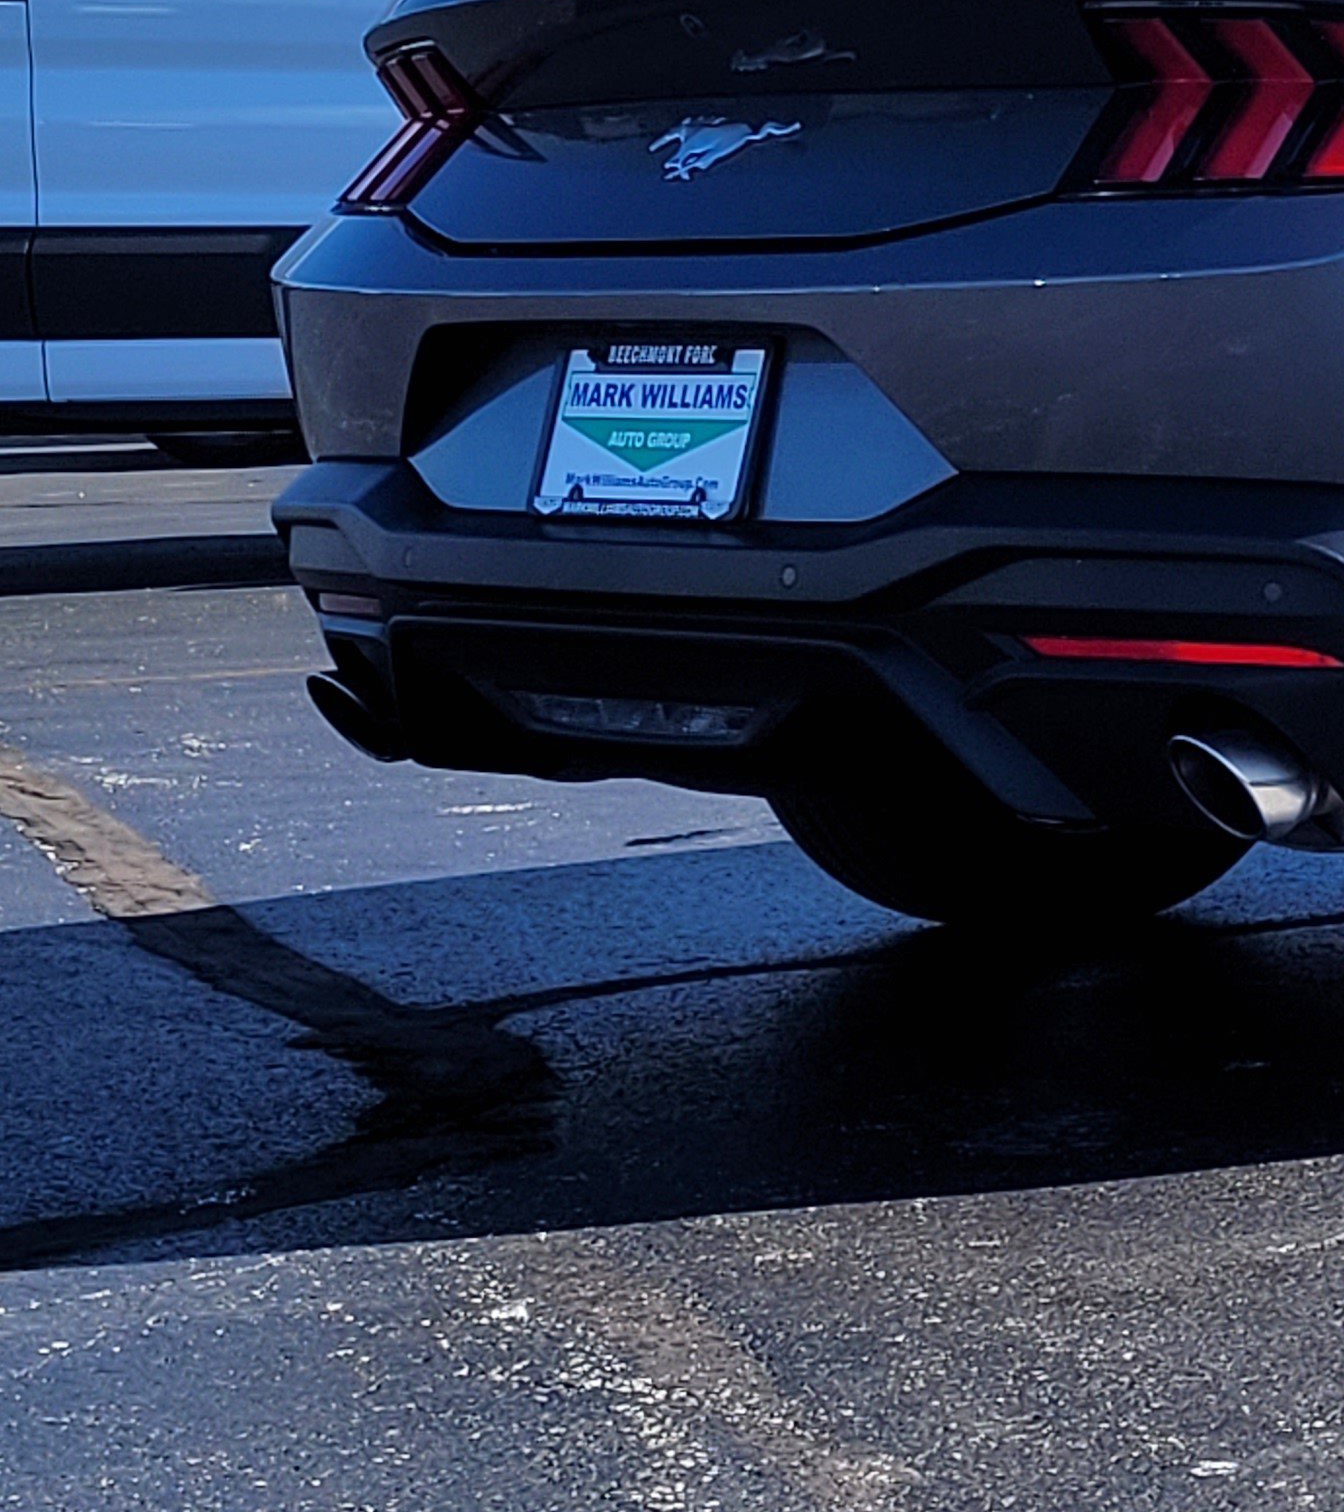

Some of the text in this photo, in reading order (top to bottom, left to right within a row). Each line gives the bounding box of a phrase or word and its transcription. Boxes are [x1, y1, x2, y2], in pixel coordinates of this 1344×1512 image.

[570, 382, 748, 410] MARK WILLIAMS
[607, 431, 691, 449] AUTO GROUP
